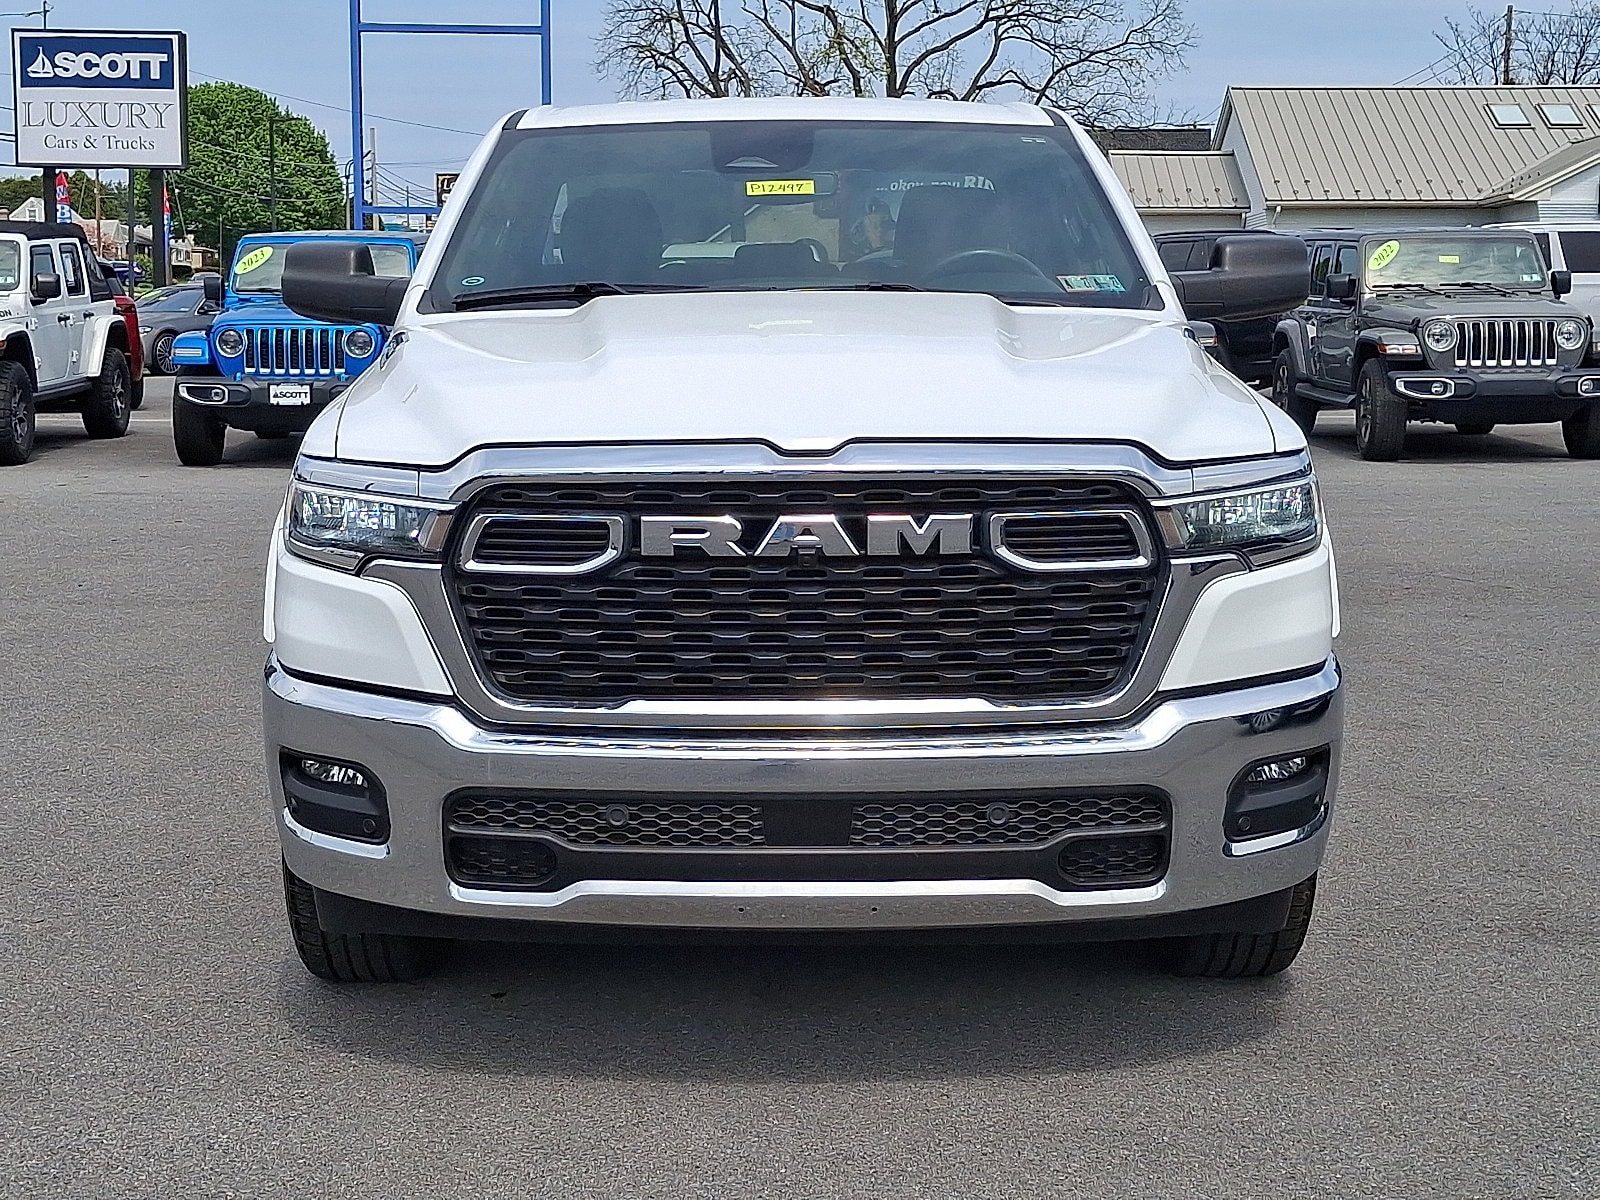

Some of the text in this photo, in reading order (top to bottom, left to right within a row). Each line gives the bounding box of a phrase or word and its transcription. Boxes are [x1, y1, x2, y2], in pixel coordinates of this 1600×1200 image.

[54, 51, 169, 80] SCOTT
[22, 101, 175, 129] LUXURY
[44, 134, 155, 150] Cars & Trucks
[241, 250, 266, 272] 2023
[1373, 244, 1394, 267] 2022
[279, 391, 309, 399] SCOTT
[640, 513, 974, 557] RAM
